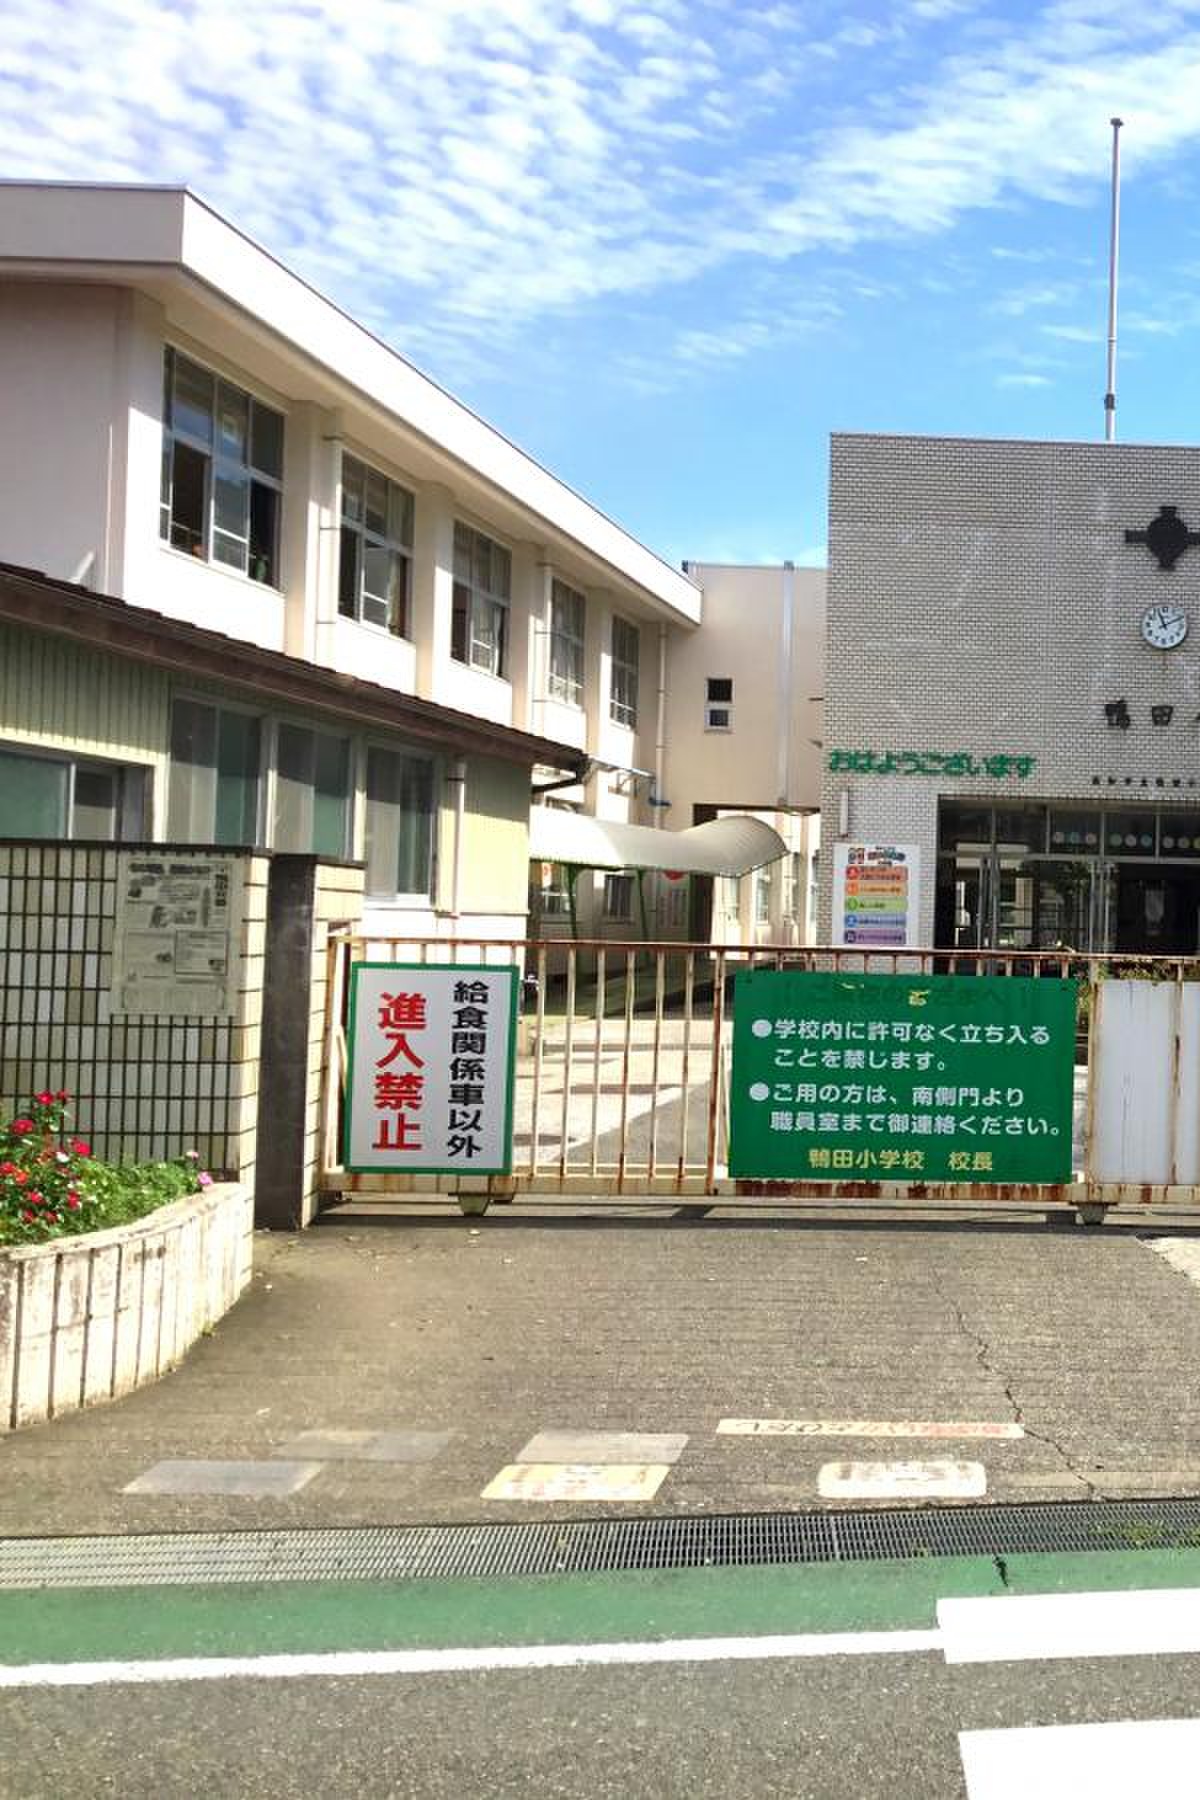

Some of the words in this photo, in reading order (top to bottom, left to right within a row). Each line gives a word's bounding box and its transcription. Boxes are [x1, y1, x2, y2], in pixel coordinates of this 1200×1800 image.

[773, 1018, 1051, 1045] 学校内に許可なく立ち入る
[371, 990, 428, 1151] 進入禁止
[446, 979, 490, 1160] 給食関係車以外
[773, 1048, 947, 1072] ことを禁じます。
[769, 1110, 1061, 1137] 職員室まで御連絡ください。
[946, 1150, 994, 1172] 校長
